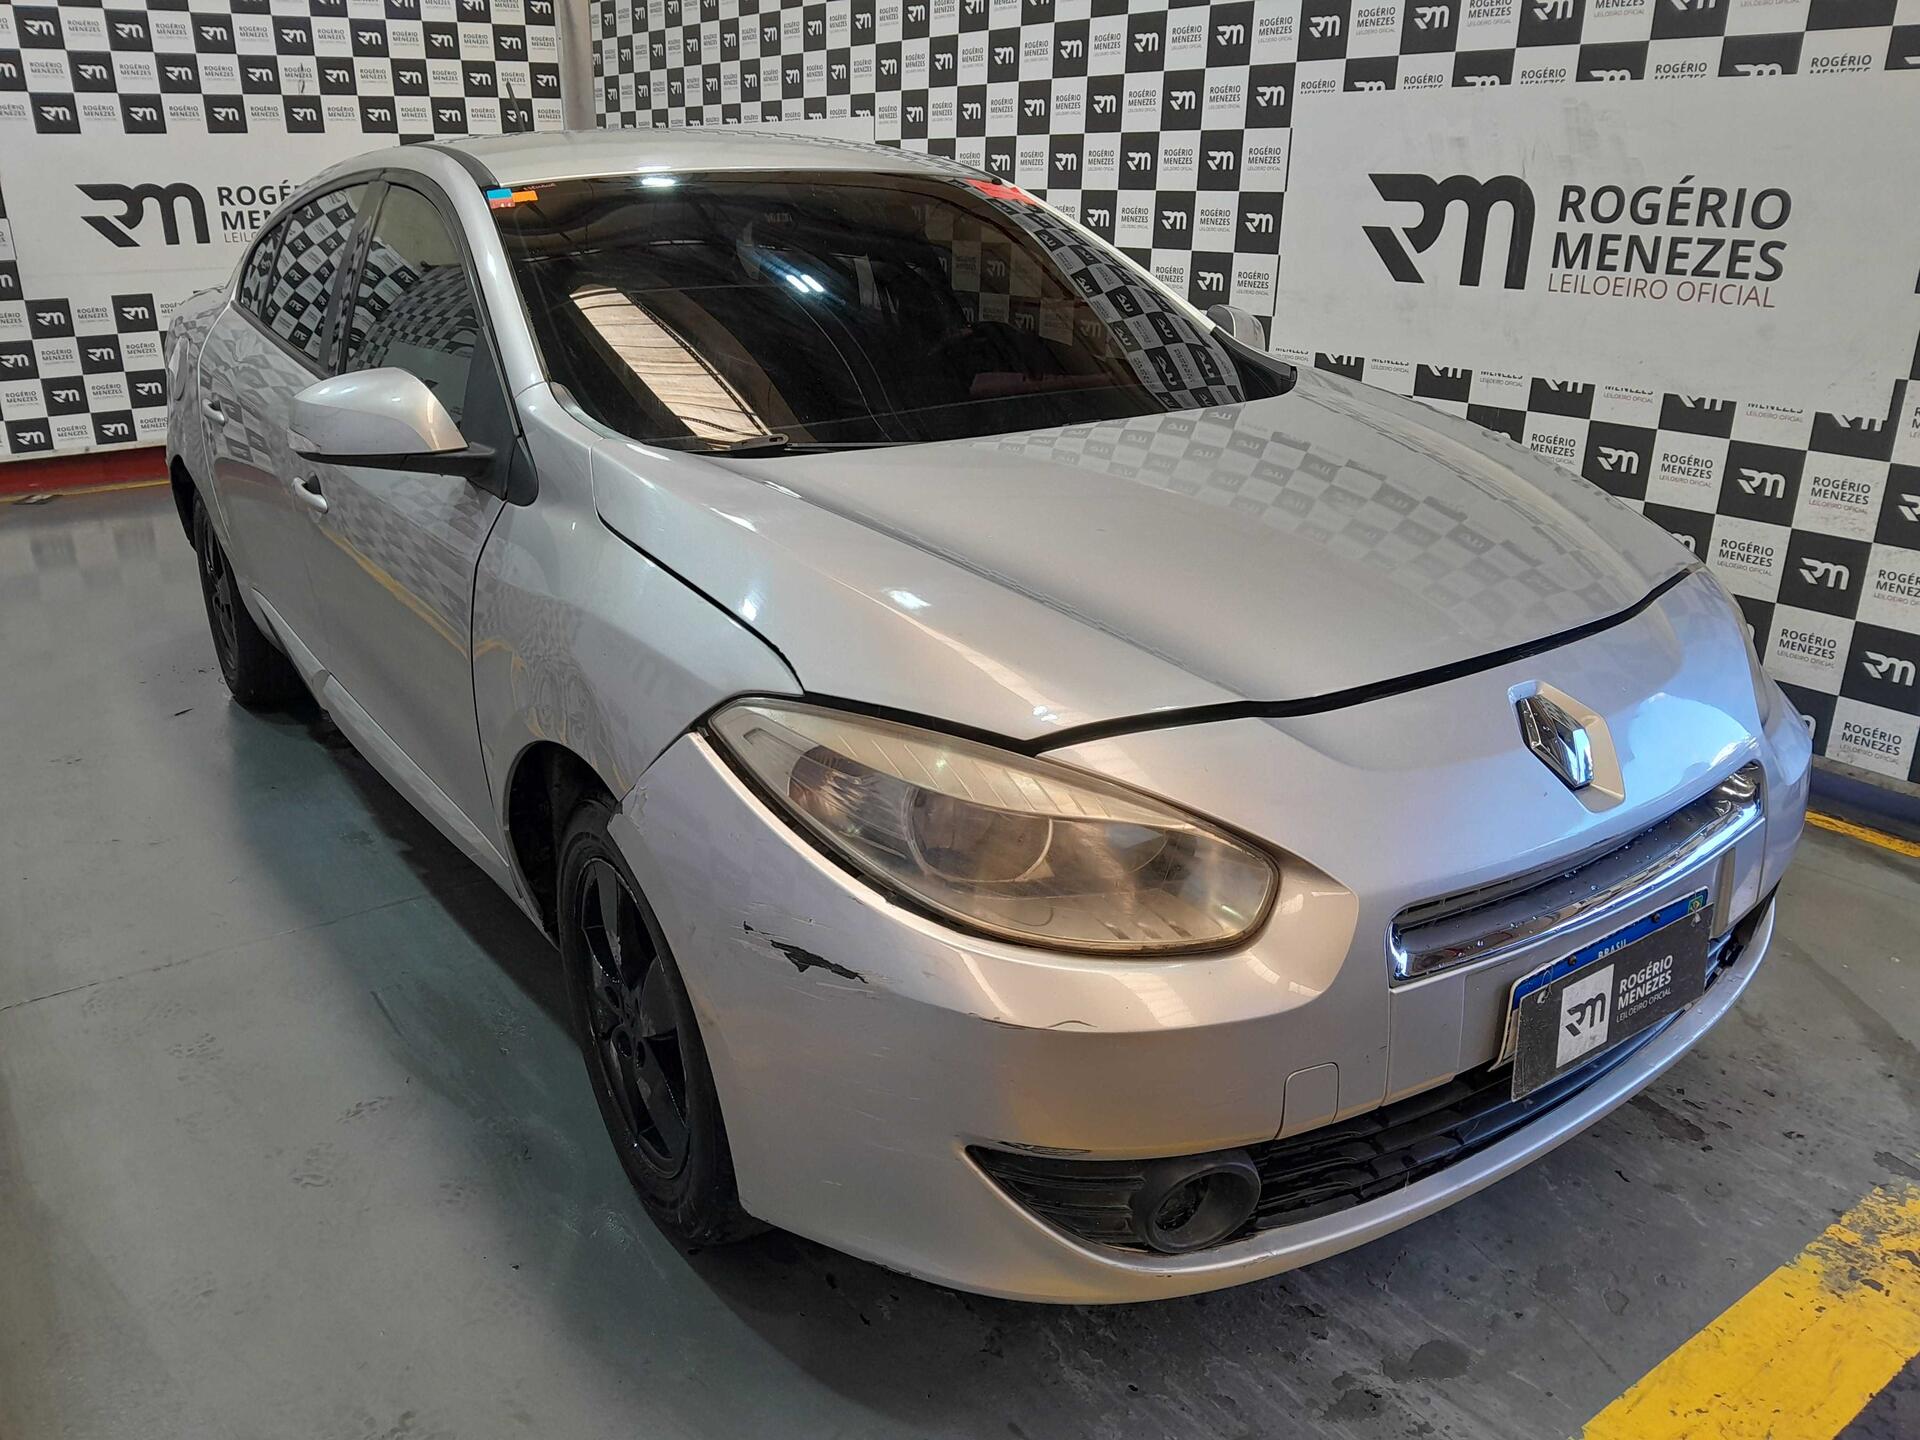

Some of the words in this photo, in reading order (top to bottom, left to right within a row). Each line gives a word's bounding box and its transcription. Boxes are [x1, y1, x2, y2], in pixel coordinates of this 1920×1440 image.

[1357, 6, 1396, 19] ROGÉRIO
[1468, 7, 1512, 19] MENEZES
[1258, 16, 1293, 26] ROGÉRIO
[1356, 16, 1395, 28] MENEZES
[1171, 24, 1202, 35] ROGÉRIO
[1258, 25, 1293, 36] MENEZES
[1093, 32, 1121, 43] ROGÉRIO
[1171, 34, 1202, 44] MENEZES
[1024, 40, 1049, 49] ROGÉRIO
[1093, 41, 1121, 50] MENEZES
[905, 53, 925, 61] ROGÉRIO
[961, 47, 984, 56] ROGÉRIO
[1024, 48, 1049, 57] MENEZES
[961, 55, 984, 63] MENEZES
[1810, 52, 1873, 69] ROGÉRIO
[905, 61, 925, 69] MENEZES
[1655, 60, 1708, 75] ROGÉRIO
[1520, 66, 1567, 80] ROGÉRIO
[1300, 78, 1336, 90] ROGÉRIO
[1403, 73, 1444, 85] ROGÉRIO
[1128, 89, 1157, 99] ROGÉRIO
[1209, 83, 1241, 95] ROGÉRIO
[990, 97, 1013, 106] ROGÉRIO
[1055, 93, 1082, 103] ROGÉRIO
[1128, 97, 1157, 107] MENEZES
[1209, 93, 1241, 103] MENEZES
[932, 102, 953, 110] ROGÉRIO
[990, 105, 1013, 113] MENEZES
[1055, 101, 1081, 110] MENEZES
[1020, 151, 1044, 159] ROGÉRIO
[1087, 149, 1114, 158] ROGÉRIO
[1163, 148, 1194, 157] ROGÉRIO
[1248, 147, 1281, 157] ROGÉRIO
[1020, 158, 1044, 166] MENEZES
[1087, 157, 1114, 166] MENEZES
[1163, 155, 1194, 165] MENEZES
[1248, 155, 1281, 164] MENEZES
[1557, 174, 1793, 231] ROGÉRIO
[74, 182, 211, 248] RM
[1121, 205, 1149, 215] ROGÉRIO
[1200, 207, 1231, 218] ROGÉRIO
[1121, 214, 1149, 223] MENEZES
[1200, 217, 1230, 226] MENEZES
[1362, 173, 1537, 290] RM
[1550, 231, 1789, 283] MENEZES
[1155, 264, 1184, 275] ROGÉRIO
[1155, 274, 1184, 283] MENEZES
[1237, 270, 1270, 281] ROGÉRIO
[1237, 279, 1269, 290] MENEZES
[1547, 272, 1669, 301] LEILOEIRO
[1675, 280, 1777, 309] OFICIAL
[1531, 432, 1577, 448] ROGÉRIO
[1530, 442, 1576, 458] MENEZES
[1661, 452, 1714, 470] ROGÉRIO
[1660, 462, 1713, 480] MENEZES
[1811, 474, 1872, 495] ROGÉRIO
[1809, 485, 1870, 507] MENEZES
[1719, 537, 1775, 558] ROGÉRIO
[1717, 548, 1774, 569] MENEZES
[1780, 627, 1838, 650] ROGÉRIO
[1778, 637, 1837, 660] MENEZES
[1843, 721, 1903, 746] ROGÉRIO
[1841, 732, 1900, 756] MENEZES
[1619, 954, 1673, 994] ROGÉRIO
[1617, 970, 1672, 1011] MENEZES
[1616, 1000, 1648, 1023] LEILOEIRO
[1648, 987, 1672, 1007] OFICIAL
